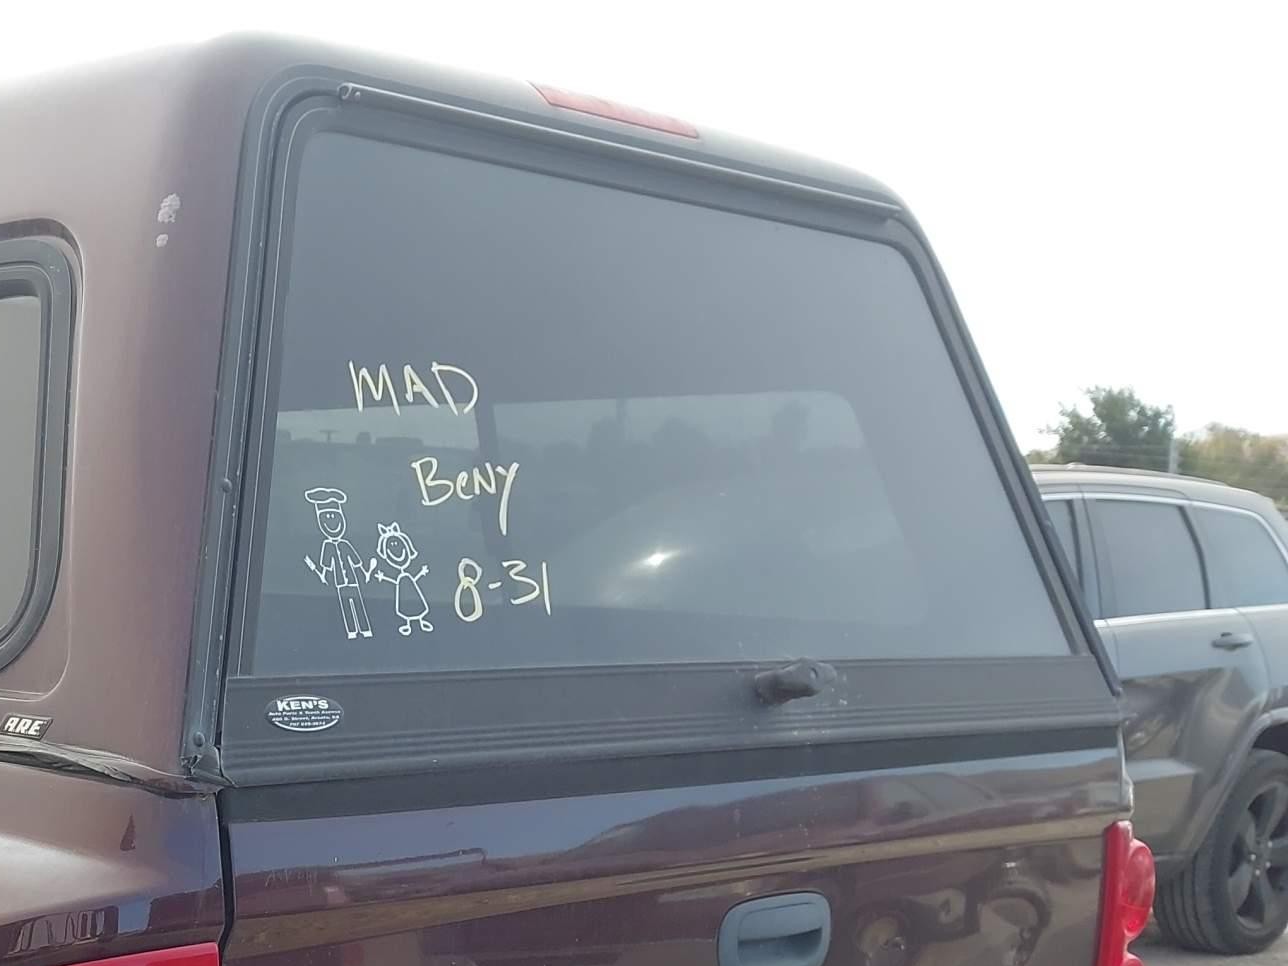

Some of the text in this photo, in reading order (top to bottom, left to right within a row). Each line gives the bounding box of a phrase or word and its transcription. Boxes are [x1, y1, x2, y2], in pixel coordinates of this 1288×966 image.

[348, 360, 479, 420] MAD
[454, 557, 552, 622] 8-31
[276, 699, 329, 711] KEN'S
